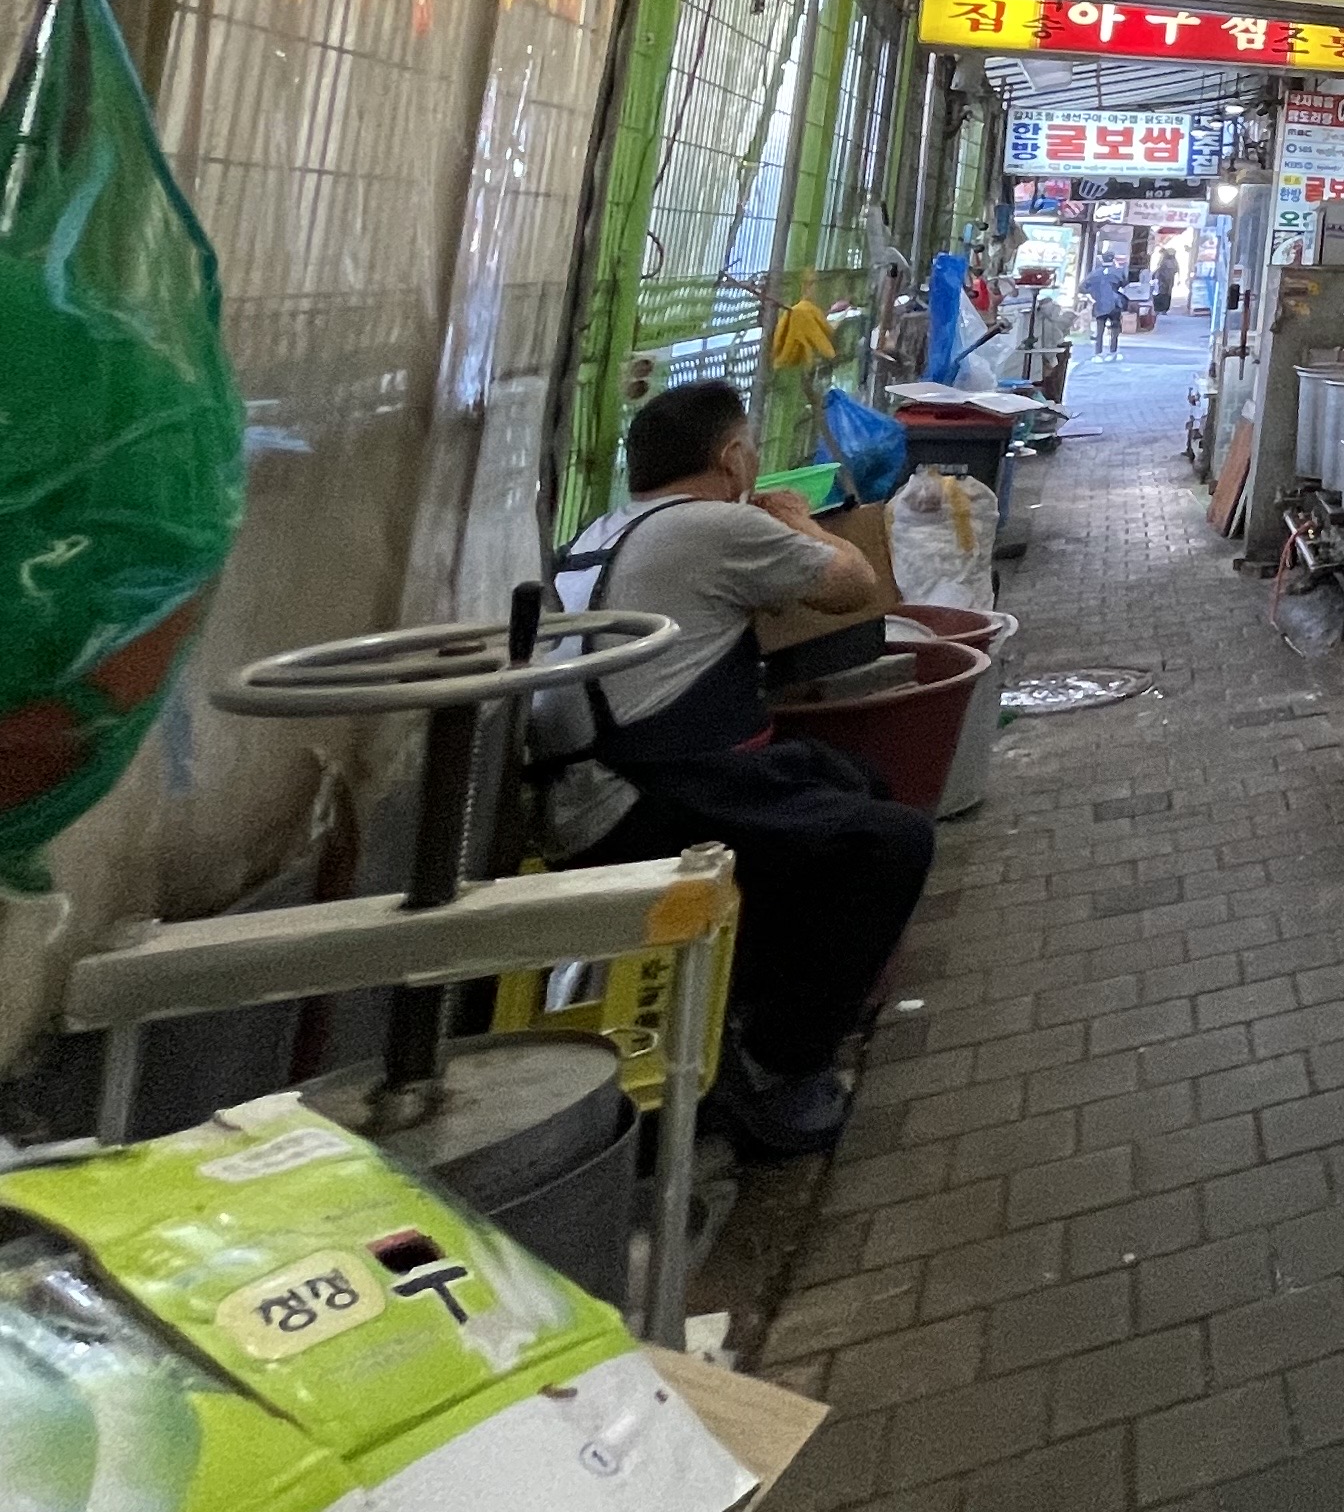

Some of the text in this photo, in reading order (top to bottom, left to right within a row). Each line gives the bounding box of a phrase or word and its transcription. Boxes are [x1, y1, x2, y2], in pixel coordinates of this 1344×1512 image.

[949, 0, 1006, 33] 집
[1011, 121, 1042, 161] 한방
[1045, 123, 1186, 164] 굴보쌈
